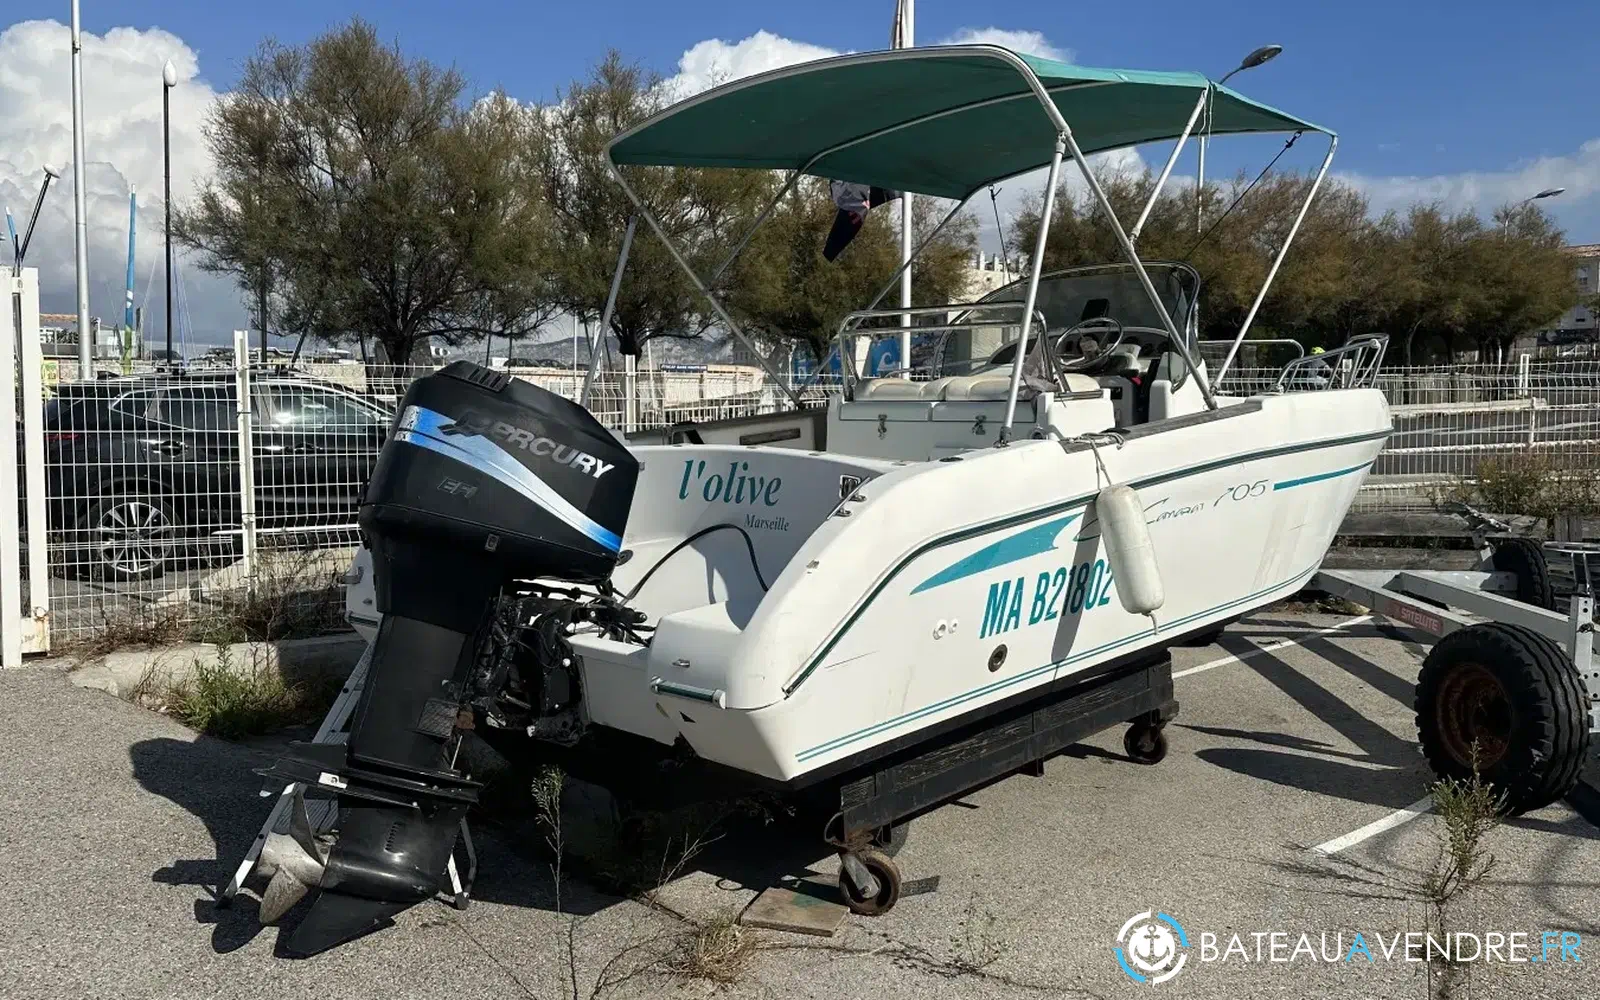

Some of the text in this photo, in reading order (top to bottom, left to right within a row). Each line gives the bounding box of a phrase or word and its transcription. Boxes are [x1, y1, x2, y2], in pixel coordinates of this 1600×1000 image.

[679, 460, 782, 506] l'olive
[1214, 480, 1269, 507] 705
[744, 514, 789, 532] Marseille
[980, 577, 1025, 639] MA
